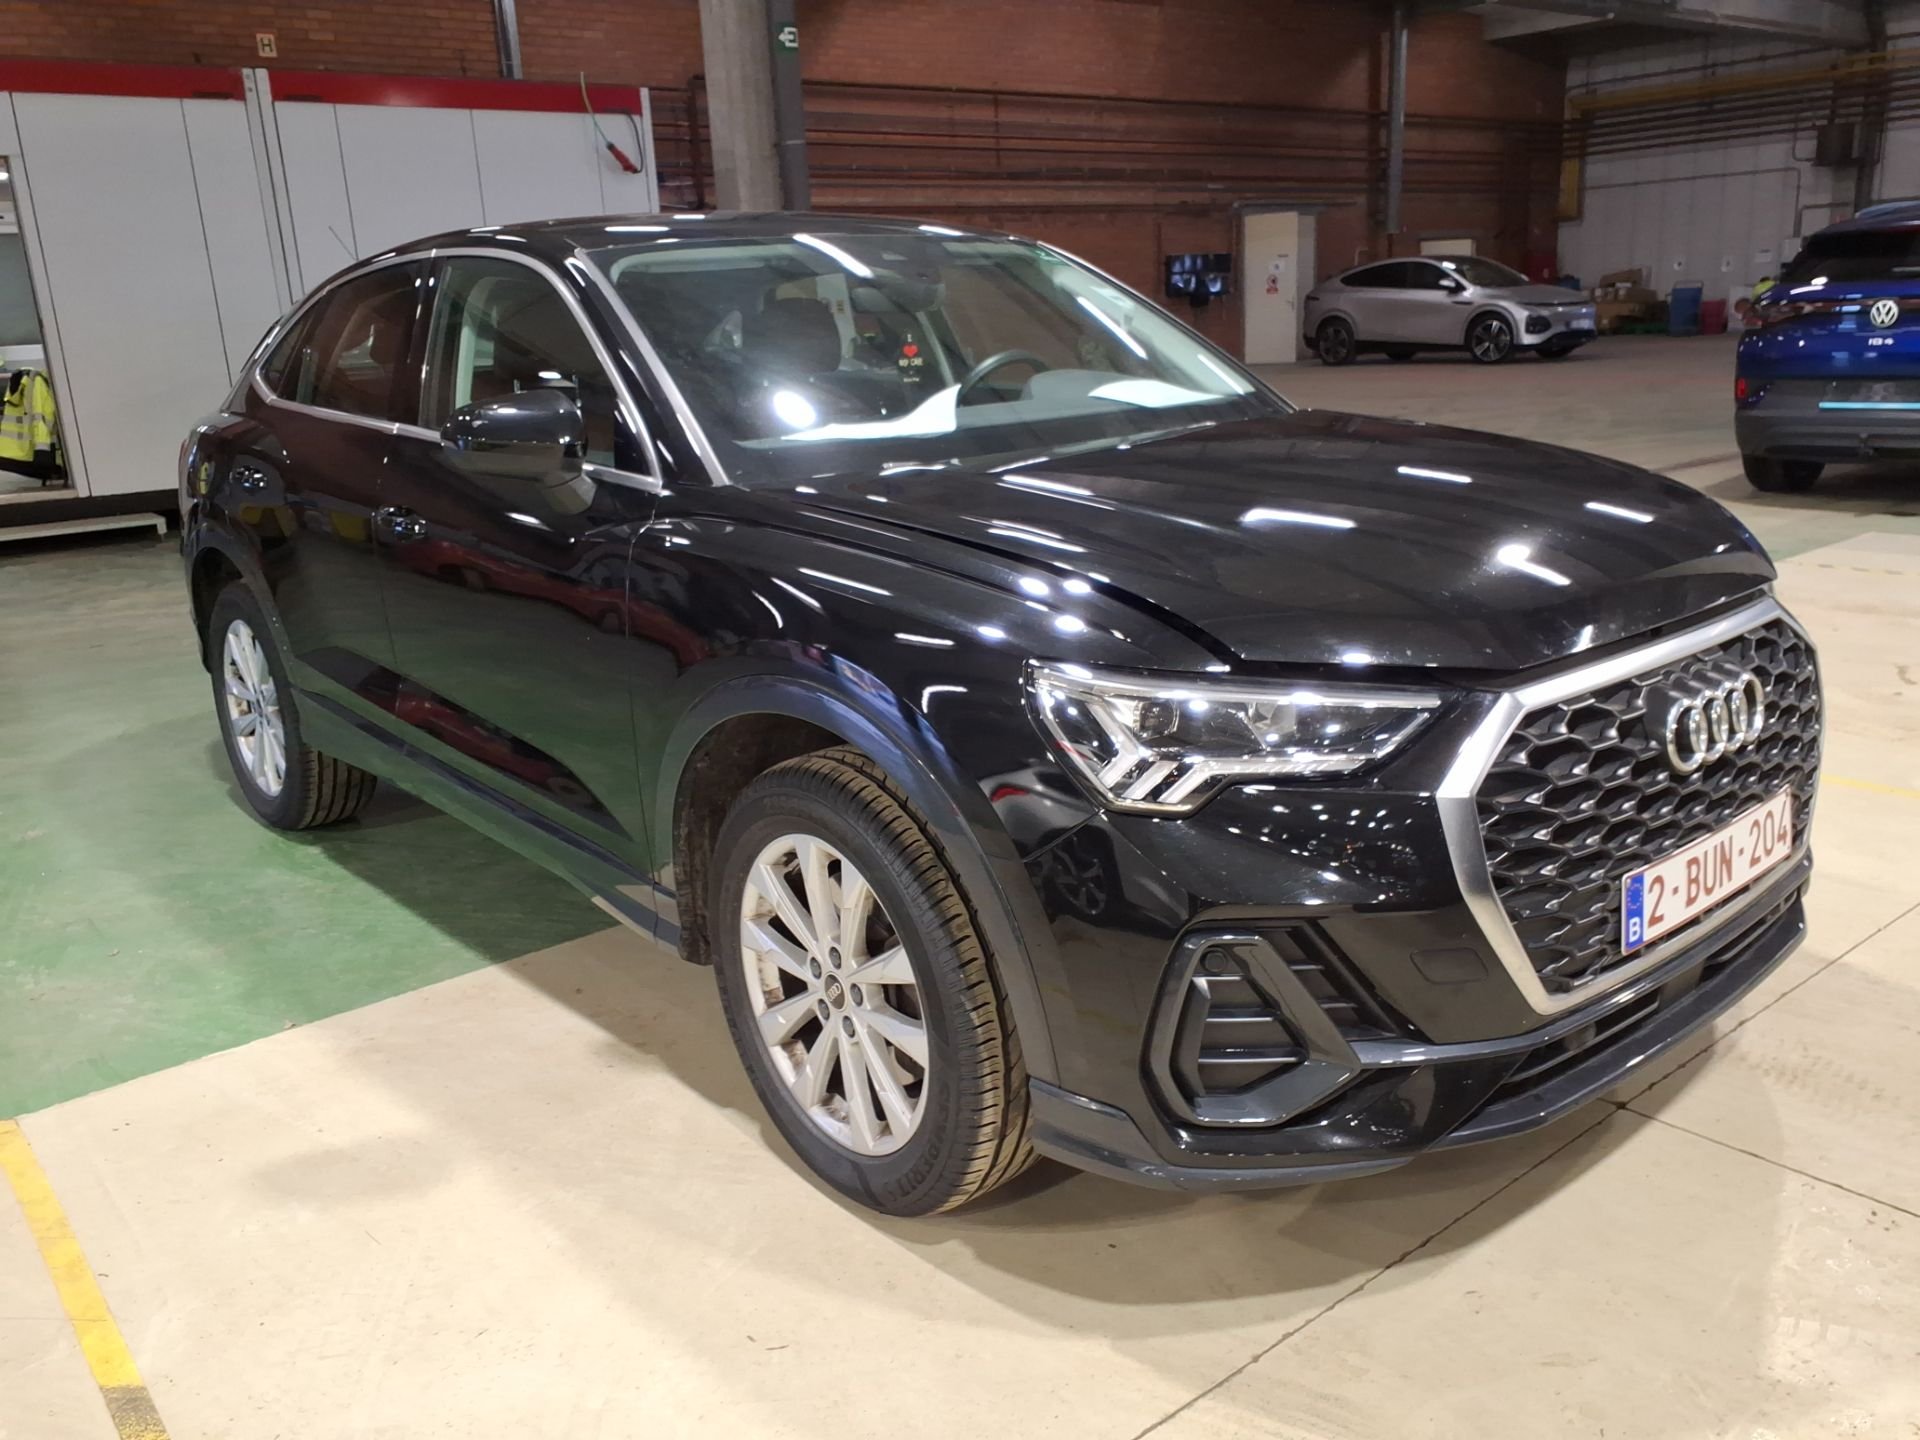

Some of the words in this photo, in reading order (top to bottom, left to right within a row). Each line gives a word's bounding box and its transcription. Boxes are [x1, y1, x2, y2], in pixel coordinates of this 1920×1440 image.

[260, 37, 273, 54] H
[1647, 799, 1788, 928] 2-BUN-204
[1628, 917, 1641, 943] B
